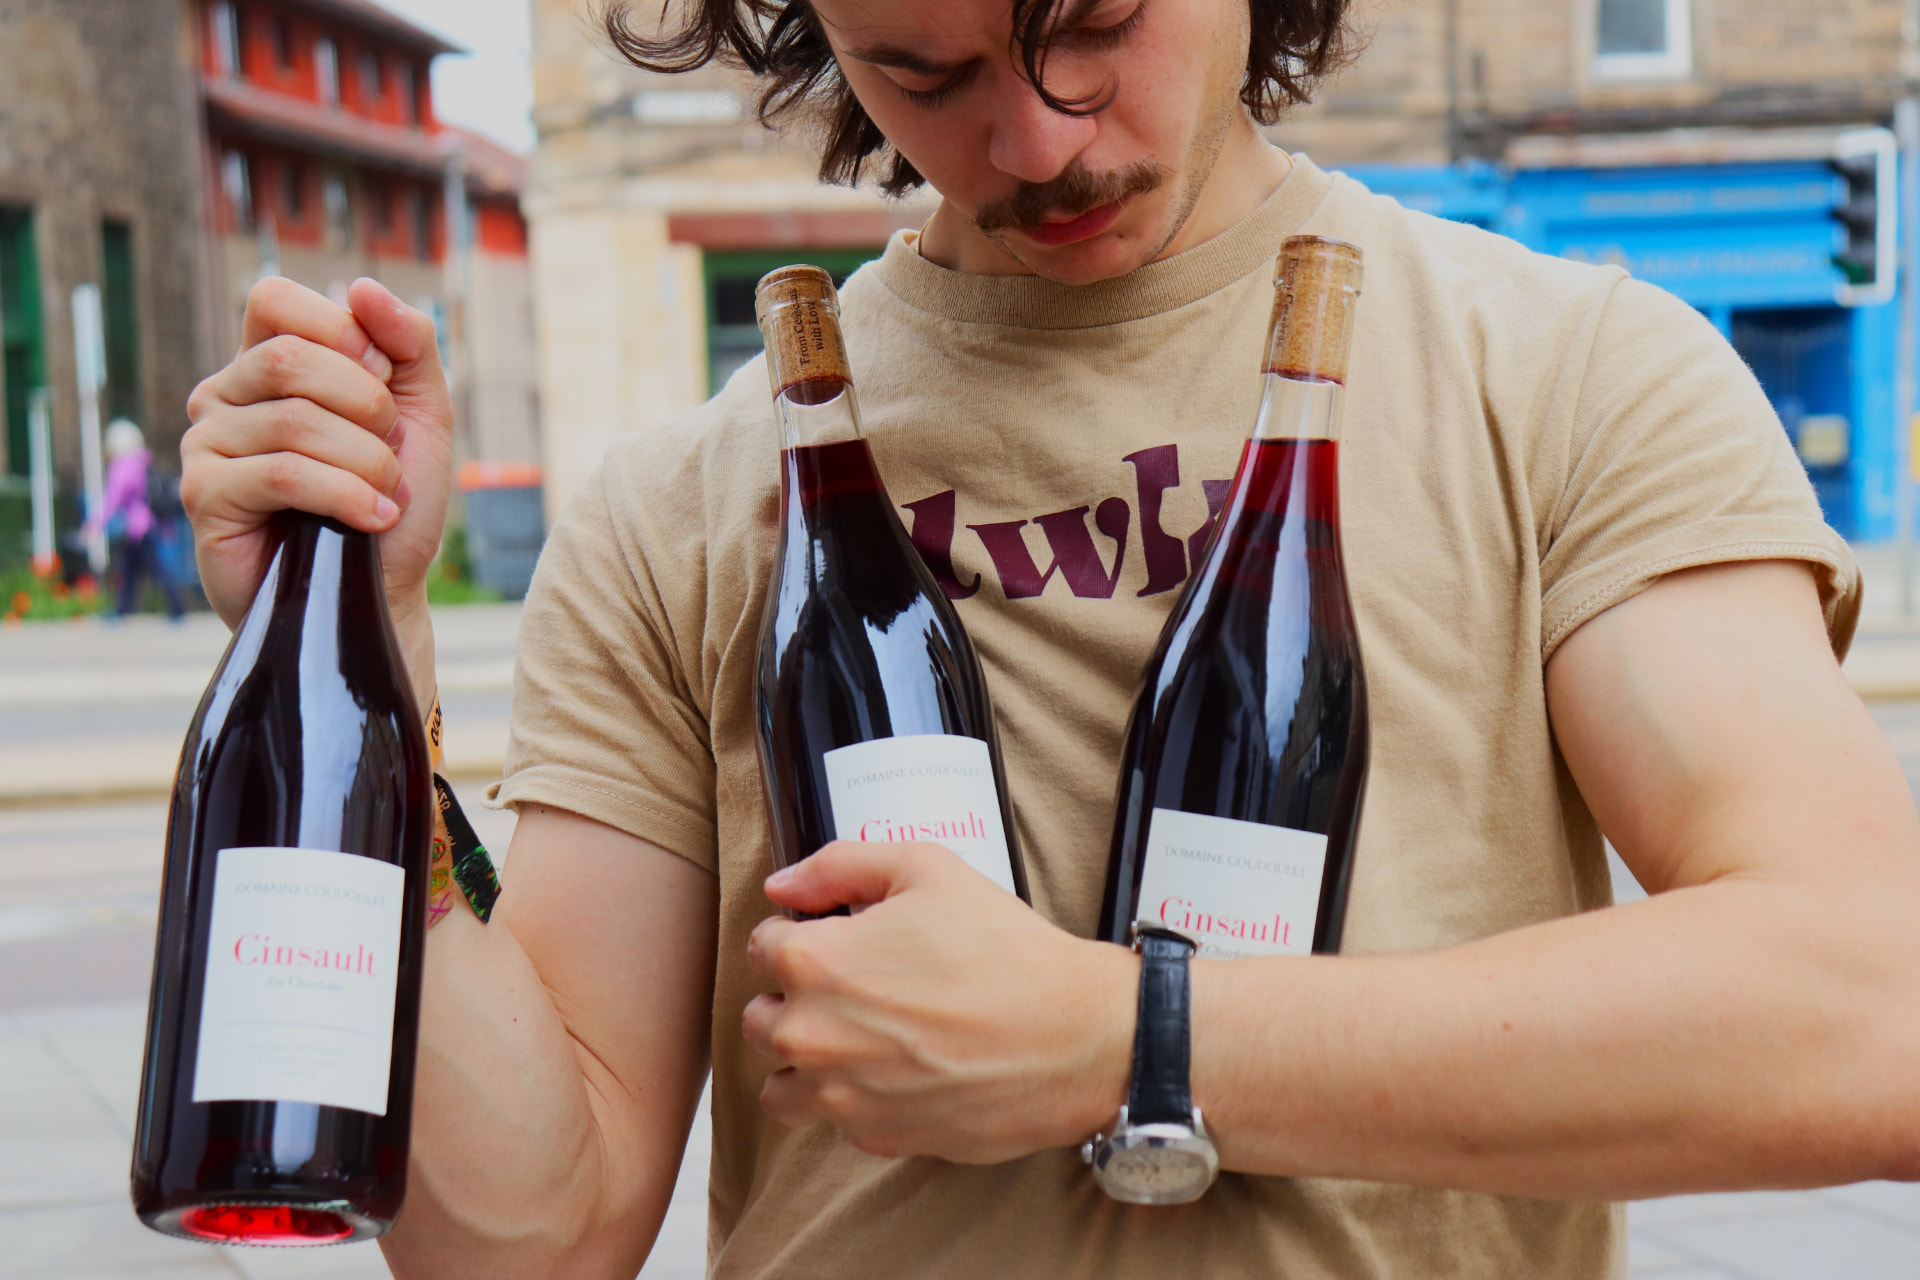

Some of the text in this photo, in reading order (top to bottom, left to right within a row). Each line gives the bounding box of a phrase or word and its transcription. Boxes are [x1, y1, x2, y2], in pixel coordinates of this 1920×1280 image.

[799, 336, 810, 366] From
[811, 327, 824, 350] with
[847, 766, 981, 788] DOMAINE COUDOULET
[860, 811, 990, 842] Cinsault
[1164, 846, 1307, 878] DOMAINE COUDOULET
[234, 882, 386, 908] DOMAINE COUDOULET
[1159, 896, 1292, 946] Cinsault
[233, 933, 377, 977] Cinsault
